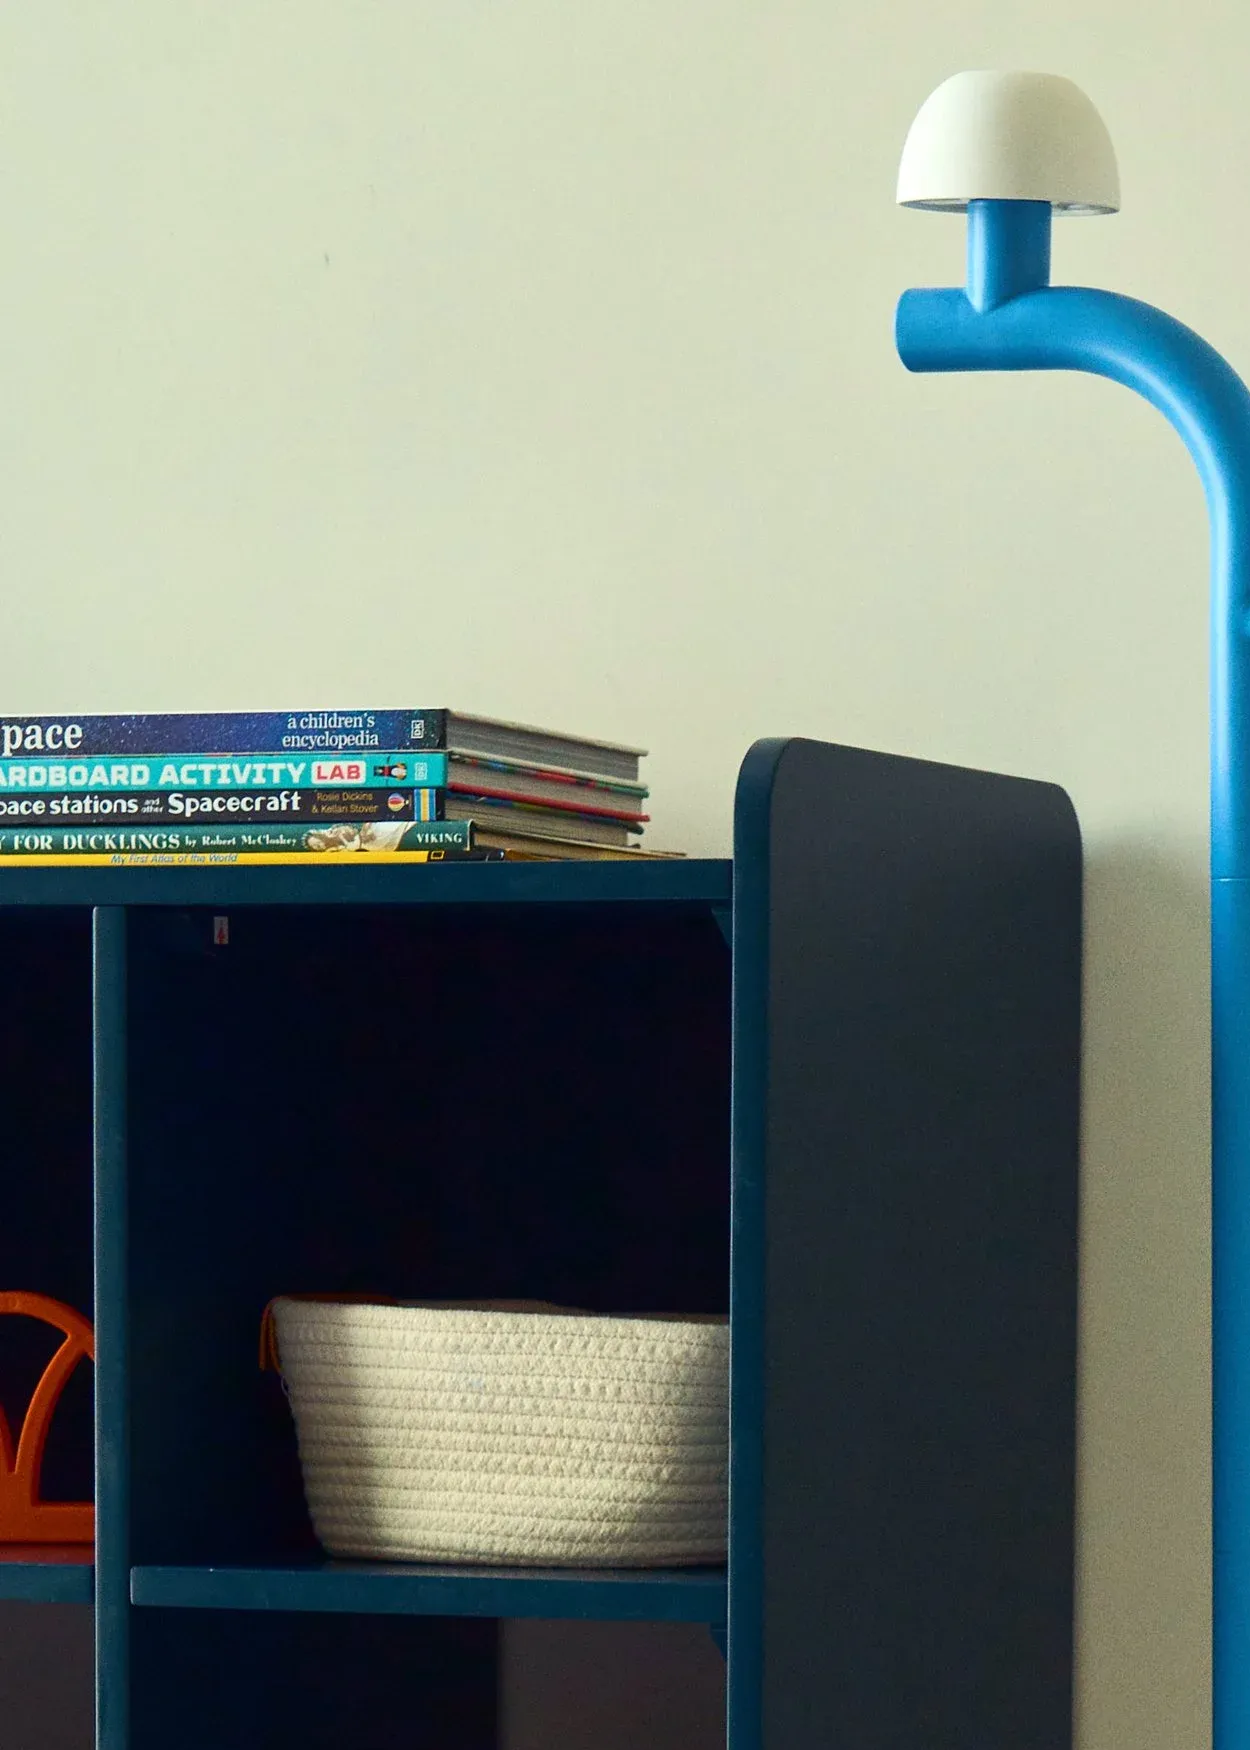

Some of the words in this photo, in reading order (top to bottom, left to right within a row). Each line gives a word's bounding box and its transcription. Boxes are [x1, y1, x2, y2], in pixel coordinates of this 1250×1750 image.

[287, 718, 297, 729] a
[301, 713, 375, 729] children's
[412, 721, 423, 737] DK
[282, 732, 379, 749] encyclopedia
[159, 763, 306, 785] ACTIVITY
[316, 764, 361, 780] LAB
[50, 795, 139, 815] stations
[168, 791, 301, 817] Spacecraft
[312, 804, 318, 813] &
[14, 834, 53, 850] FOR
[63, 833, 181, 850] DUCKLINGS
[185, 835, 196, 847] by
[202, 835, 236, 846] Robert
[241, 834, 297, 847] McCloskey
[416, 833, 462, 844] VIKING
[111, 855, 125, 864] My
[129, 854, 149, 863] First
[151, 854, 174, 863] Atlas
[178, 854, 188, 863] of
[191, 853, 205, 862] the
[209, 853, 238, 862] World
